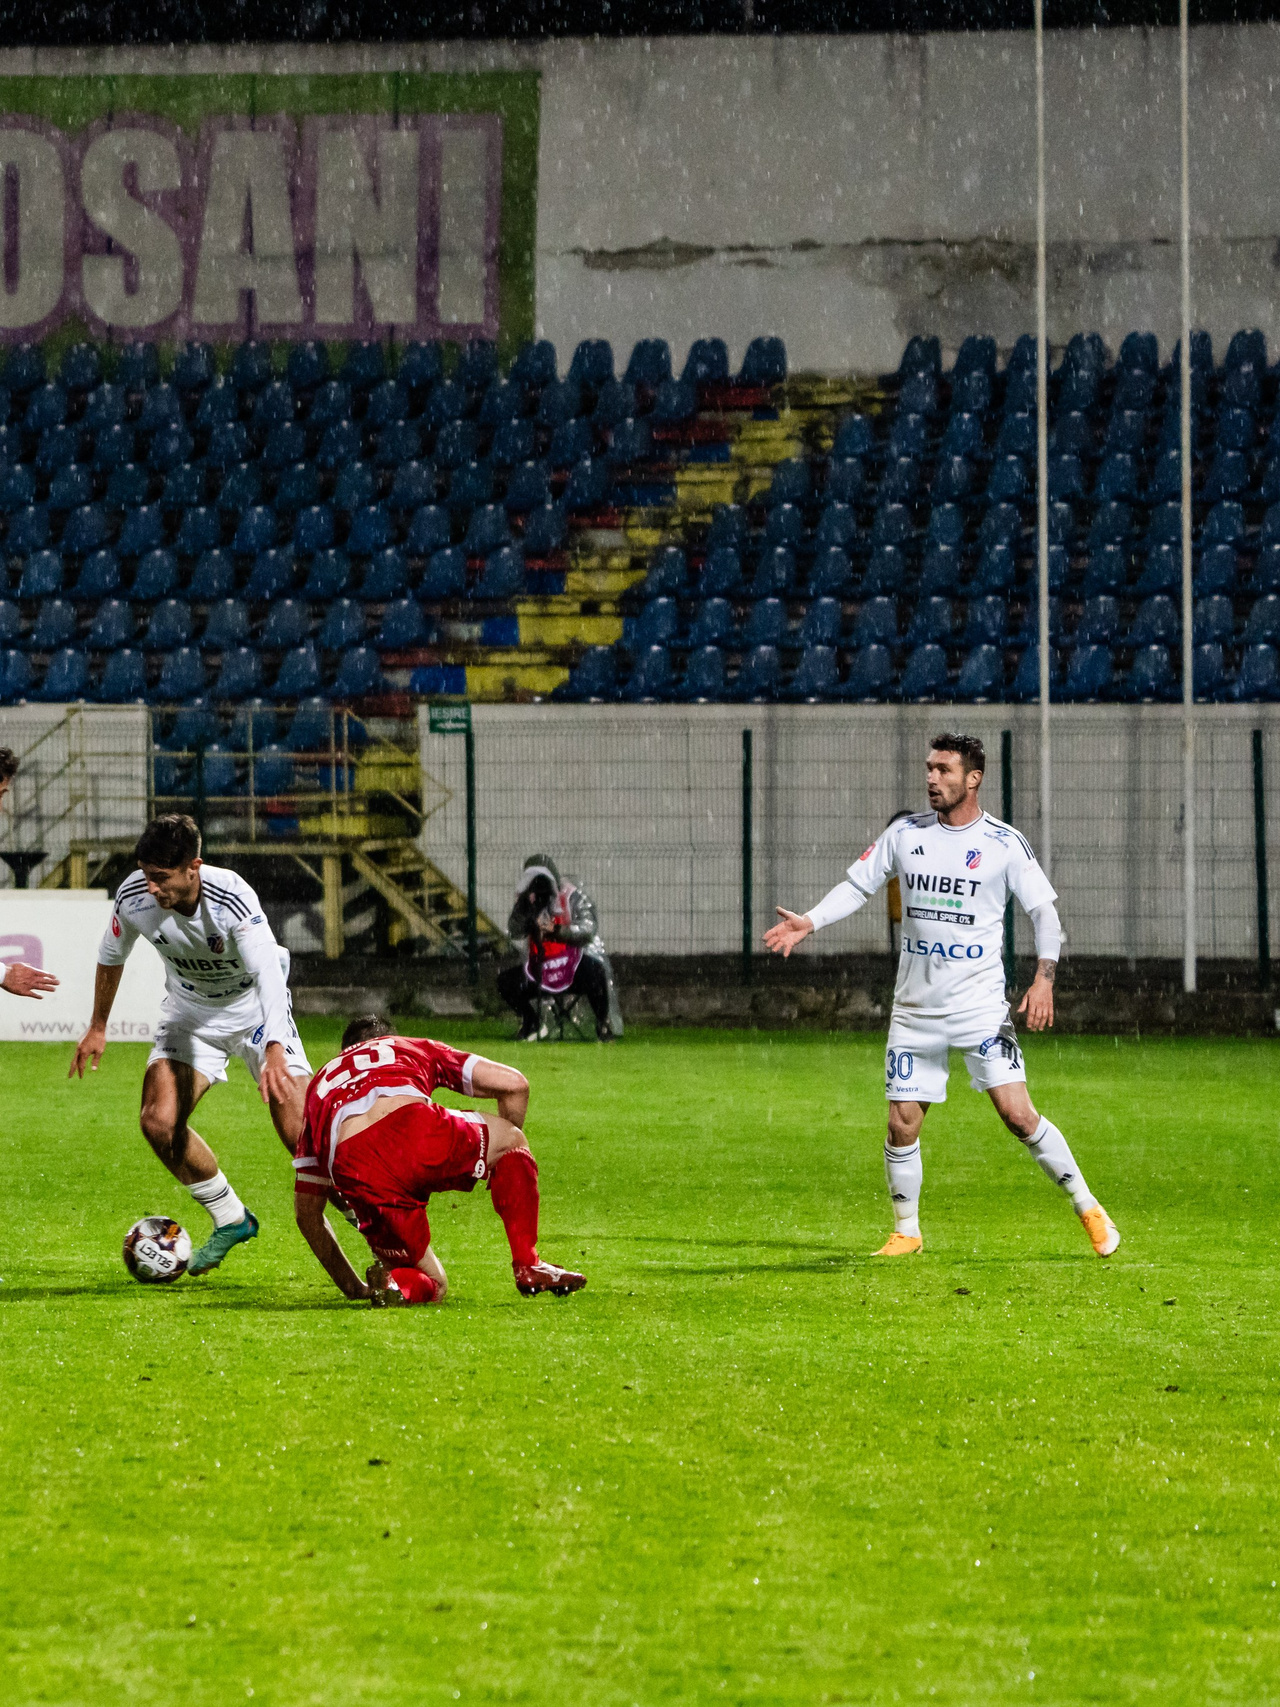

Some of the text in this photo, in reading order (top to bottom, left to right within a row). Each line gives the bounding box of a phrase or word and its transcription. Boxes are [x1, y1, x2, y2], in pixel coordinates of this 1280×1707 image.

[905, 873, 981, 897] UNIBET
[940, 912, 958, 923] SPRE
[886, 1049, 913, 1080] 30
[896, 1085, 919, 1093] Vestra
